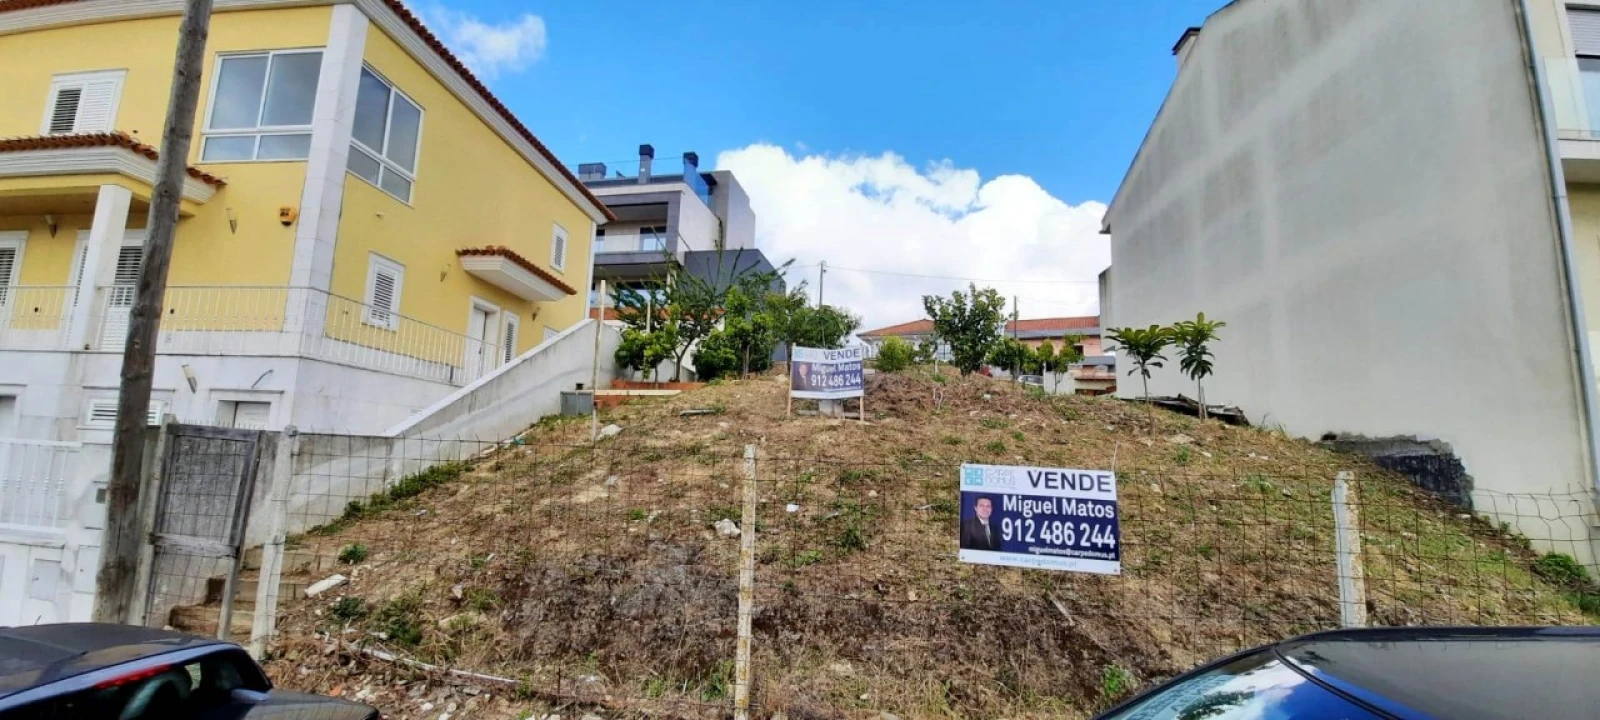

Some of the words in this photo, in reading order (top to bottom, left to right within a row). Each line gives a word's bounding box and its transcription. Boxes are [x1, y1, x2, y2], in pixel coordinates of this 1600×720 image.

[823, 349, 861, 360] VENDE
[838, 363, 861, 371] Matos
[811, 374, 828, 387] 912
[828, 374, 844, 386] 486
[845, 373, 861, 386] 244
[1027, 470, 1112, 493] VENDE
[1003, 494, 1059, 518] Miguel
[1062, 498, 1115, 518] Matos
[1002, 518, 1035, 542] 912
[1039, 520, 1076, 546] 486
[1079, 523, 1116, 549] 244
[1028, 546, 1116, 560] miguelmatos@carpedomus.pt
